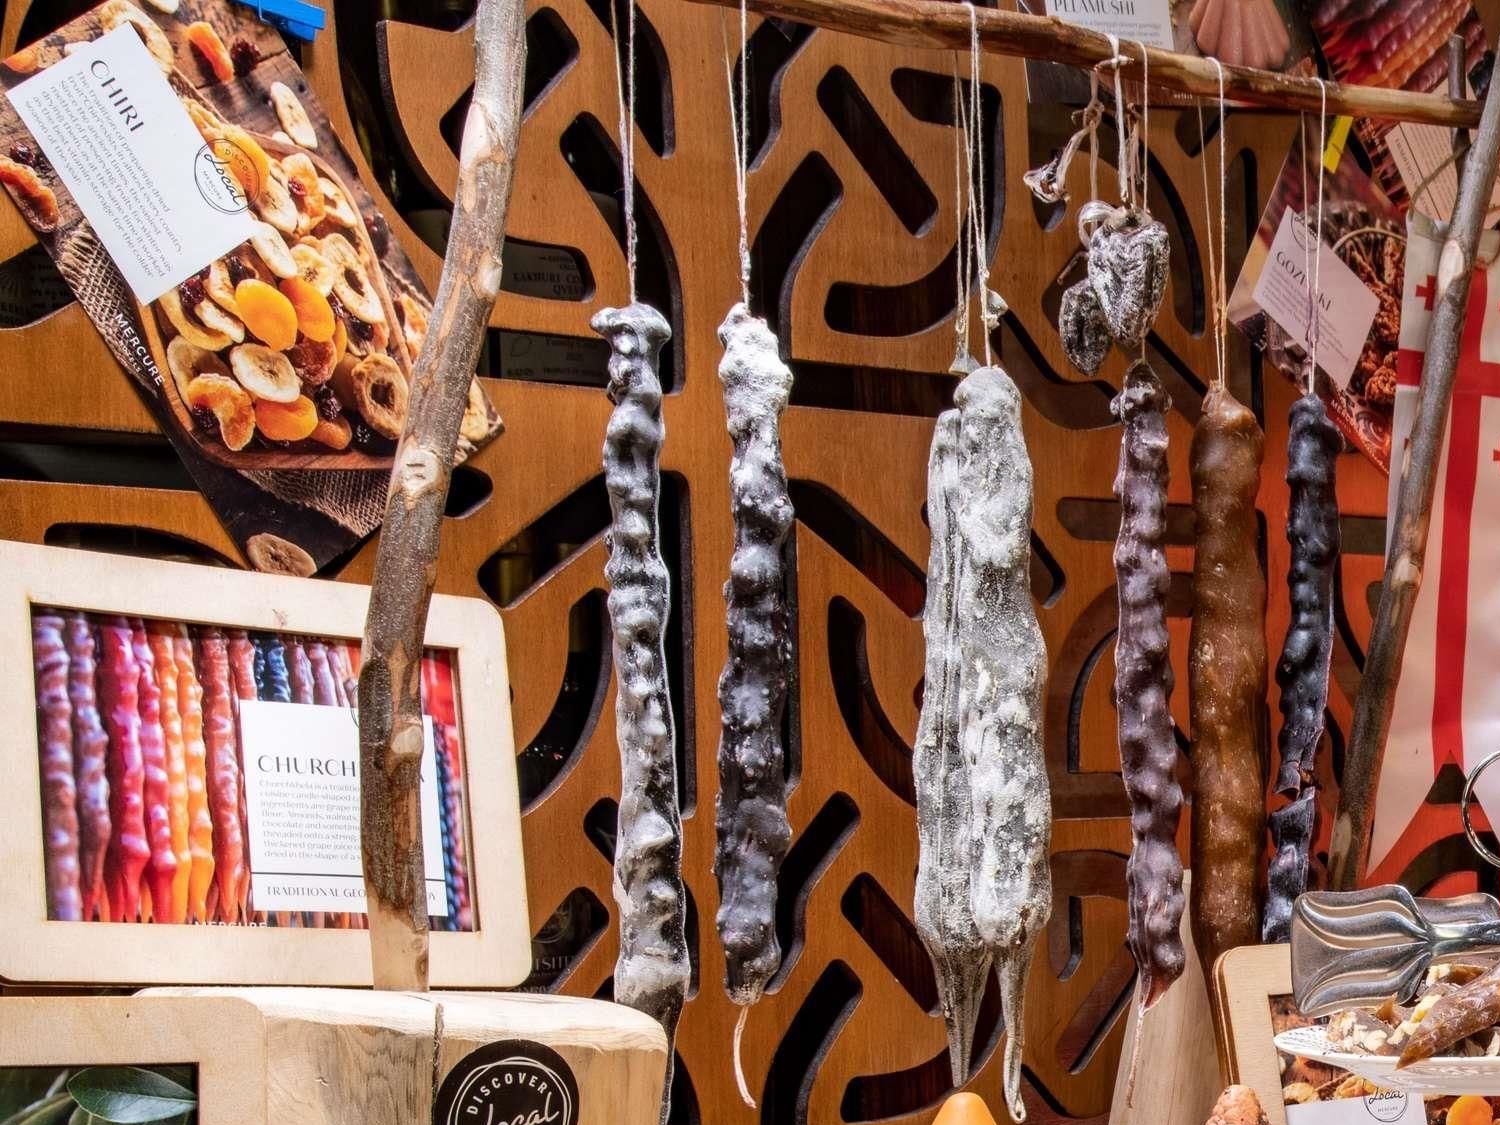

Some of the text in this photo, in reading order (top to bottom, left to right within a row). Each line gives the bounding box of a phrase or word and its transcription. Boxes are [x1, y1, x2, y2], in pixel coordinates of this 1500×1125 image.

[90, 60, 144, 131] CHIRI
[203, 153, 246, 206] Local
[1275, 249, 1332, 313] GOZIKI
[115, 313, 165, 386] MERCURE
[266, 886, 342, 898] TRADITIONAL
[466, 1072, 548, 1115] DISCOVER
